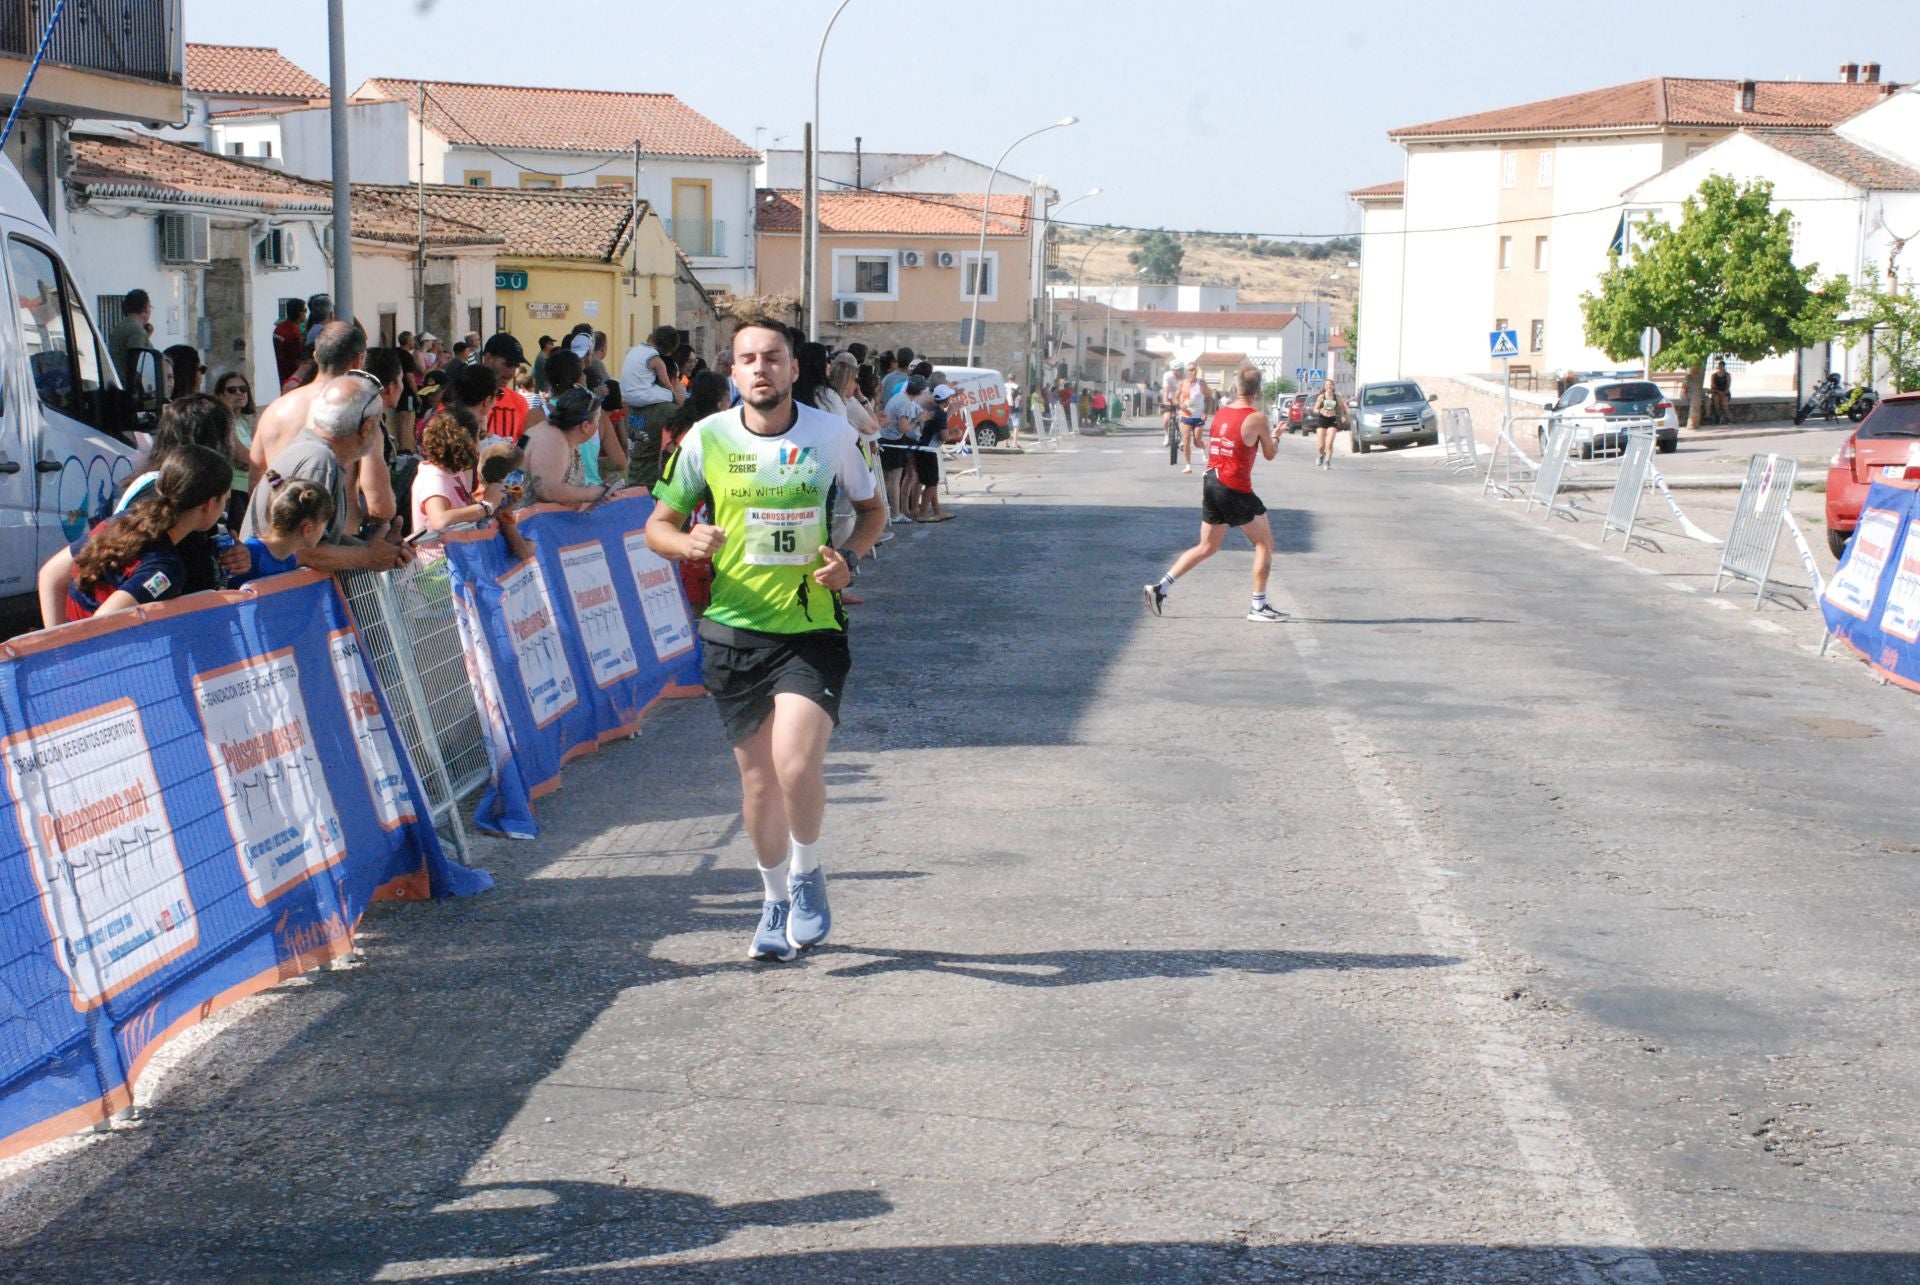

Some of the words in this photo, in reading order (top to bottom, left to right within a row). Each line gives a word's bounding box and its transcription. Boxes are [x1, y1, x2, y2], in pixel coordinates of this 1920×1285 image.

[728, 464, 756, 473] 226ERS
[731, 487, 751, 497] RUN
[756, 485, 784, 497] WITH
[761, 512, 786, 520] CROSS
[771, 530, 796, 552] 15
